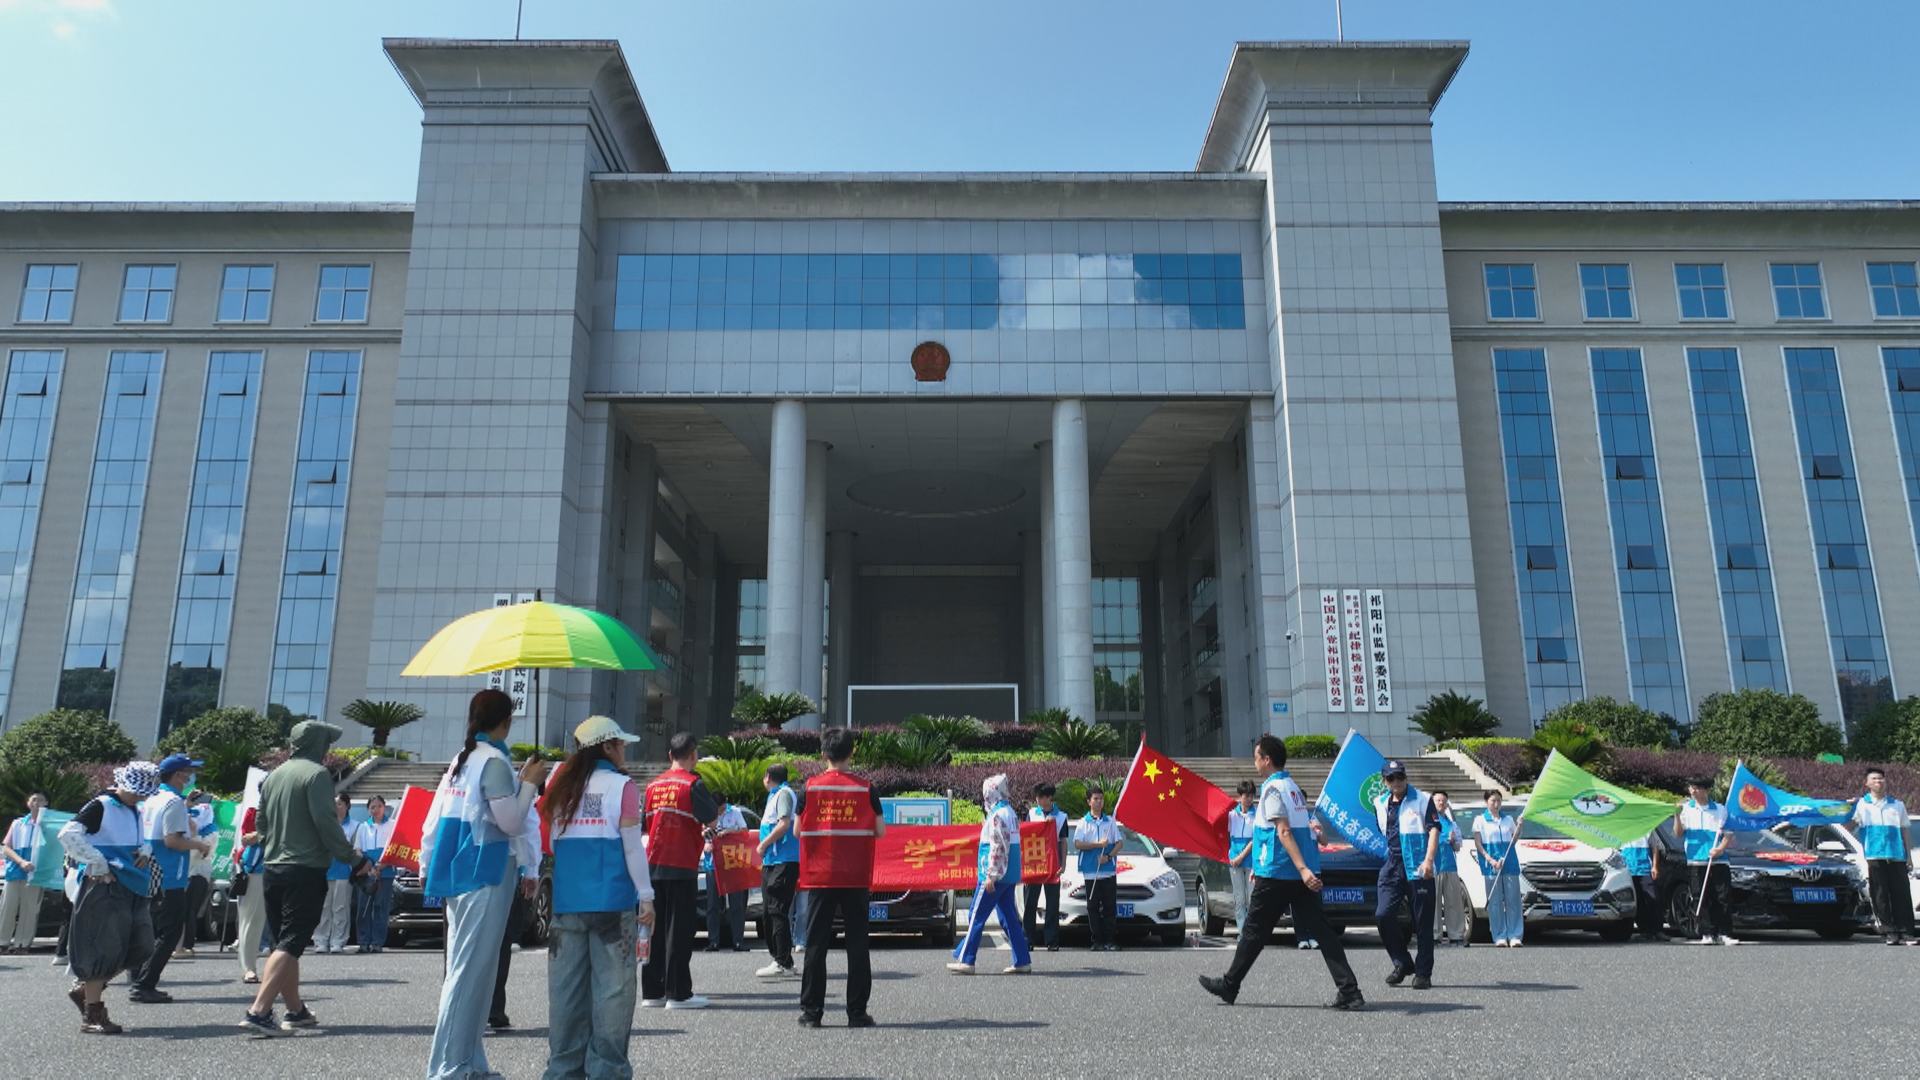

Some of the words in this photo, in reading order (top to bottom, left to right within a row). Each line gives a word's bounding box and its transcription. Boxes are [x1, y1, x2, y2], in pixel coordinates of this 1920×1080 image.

[1370, 594, 1389, 706] 祁阳市监察委员会
[722, 843, 752, 870] 助
[904, 838, 973, 869] 学子
